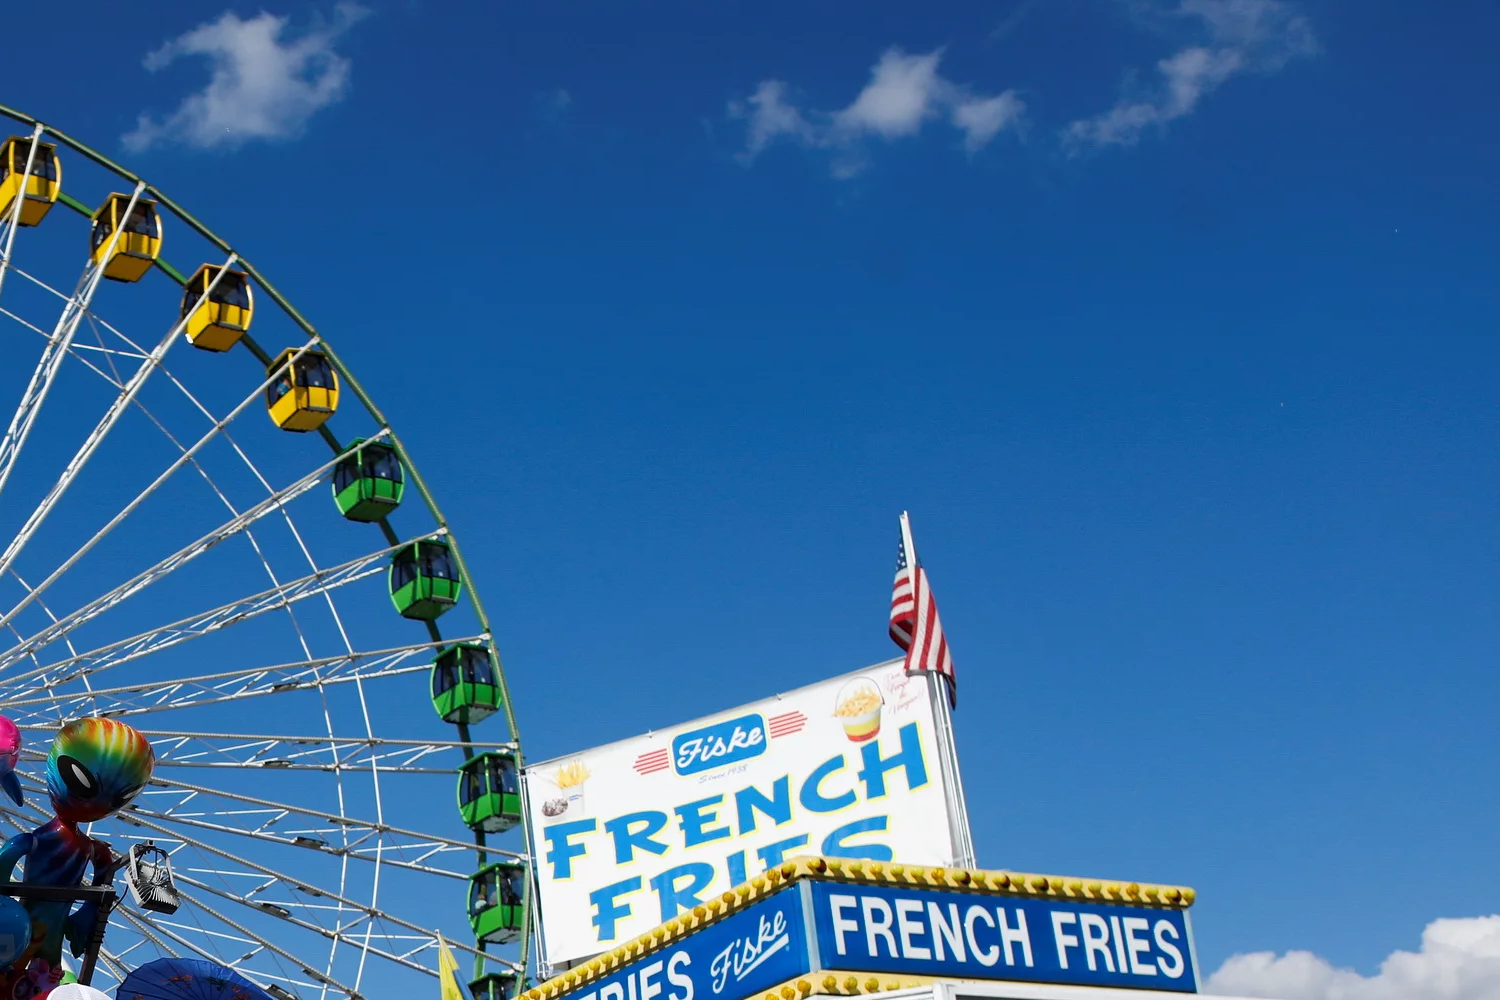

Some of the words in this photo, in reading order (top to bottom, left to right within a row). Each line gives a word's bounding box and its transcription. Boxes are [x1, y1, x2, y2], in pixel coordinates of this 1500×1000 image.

[676, 725, 764, 768] Fiske
[543, 721, 929, 879] FRENCH
[710, 908, 787, 994] Fiske
[829, 894, 1034, 969] FRENCH
[1050, 910, 1185, 979] FRIES
